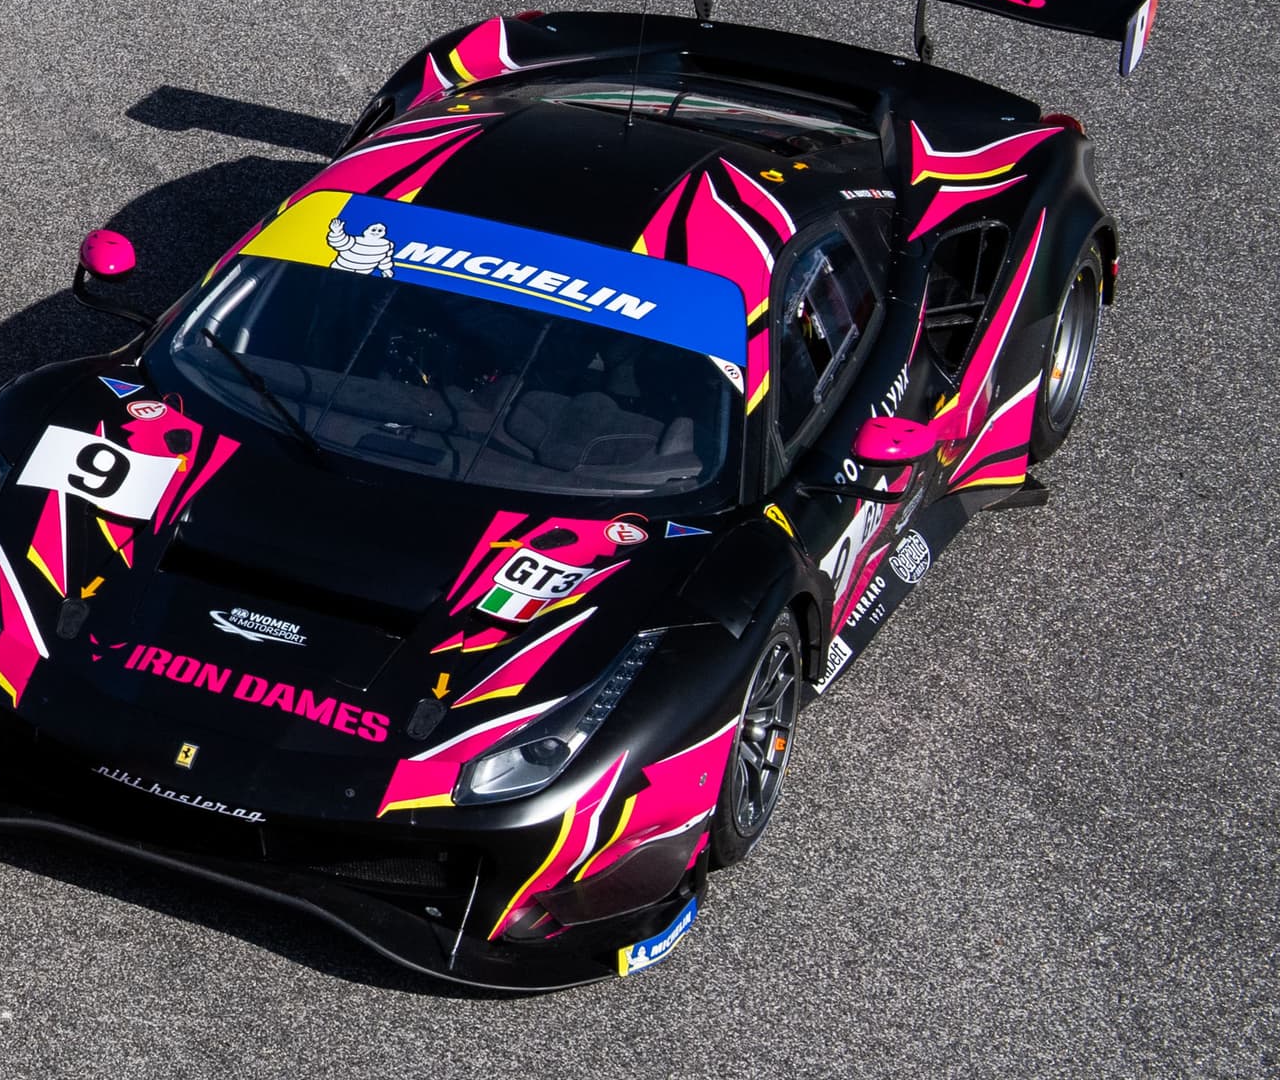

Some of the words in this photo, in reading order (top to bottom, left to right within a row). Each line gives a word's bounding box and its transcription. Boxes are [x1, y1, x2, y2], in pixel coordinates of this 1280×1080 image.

[395, 241, 657, 321] MICHELIN
[67, 442, 131, 499] 9
[504, 555, 584, 594] GT3
[249, 612, 300, 634] WOMEN
[846, 576, 887, 627] CARRARO
[869, 604, 887, 625] 1927
[238, 619, 307, 645] MOTORSPORT
[124, 644, 233, 694] IRON
[233, 673, 391, 744] DAMES
[90, 765, 150, 791] niki
[149, 783, 228, 815] hasler
[226, 807, 267, 823] ag
